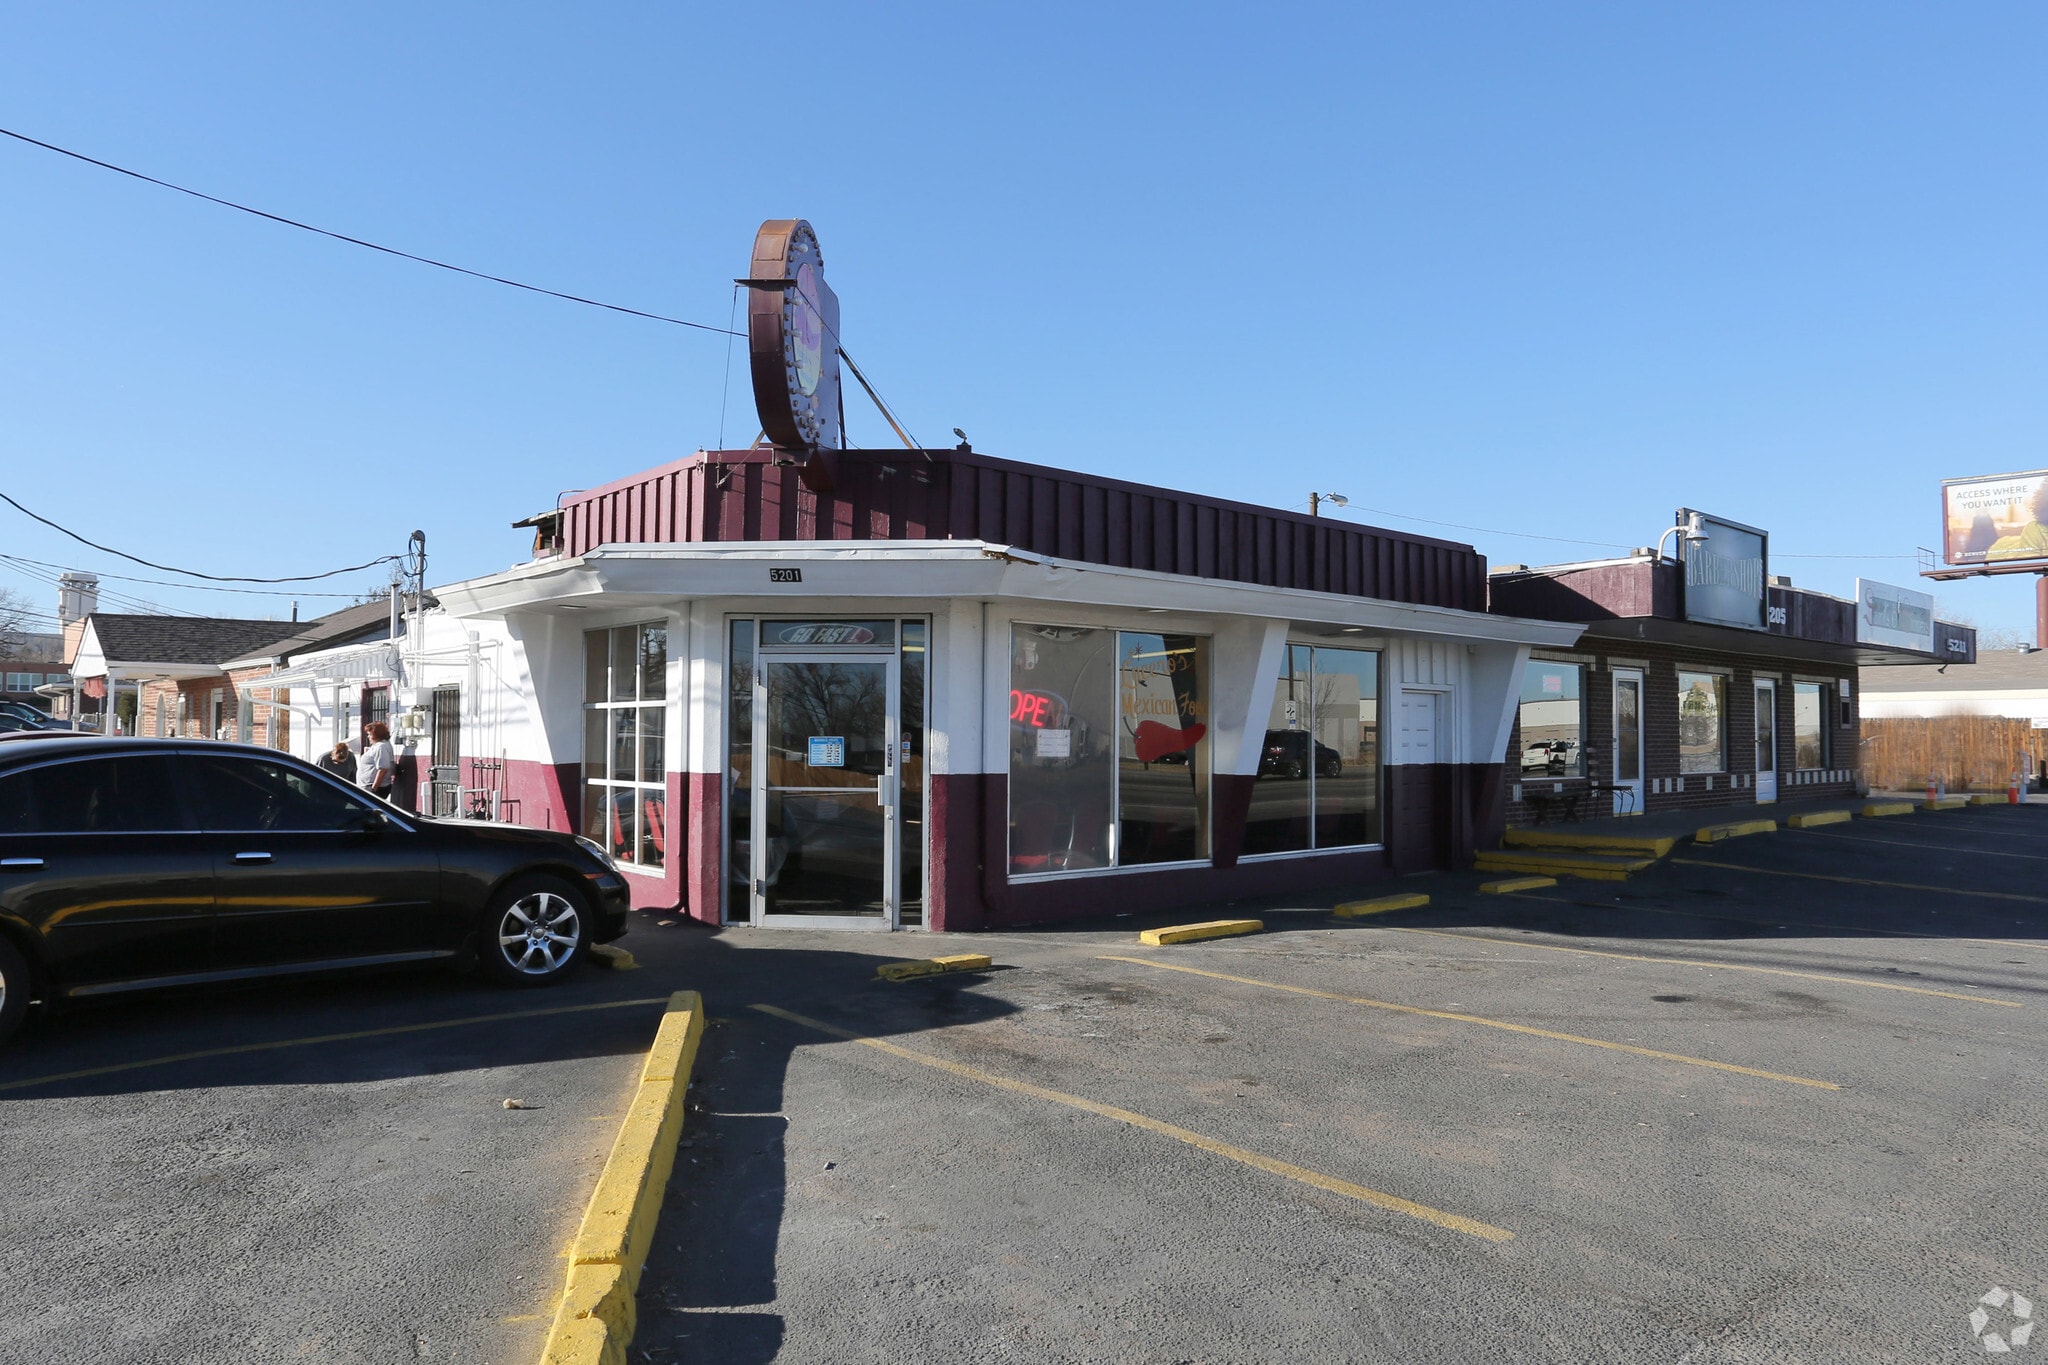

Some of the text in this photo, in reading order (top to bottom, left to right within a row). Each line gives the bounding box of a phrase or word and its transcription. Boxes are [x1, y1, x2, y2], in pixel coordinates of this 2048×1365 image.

[1956, 485, 2028, 500] ACCESS WHERE
[1962, 496, 2023, 509] YOU WANT IT
[771, 568, 800, 582] 5201
[1769, 606, 1787, 625] 205
[790, 627, 816, 643] GO
[1947, 638, 1967, 653] 5211
[1009, 689, 1063, 728] OPEN
[1121, 692, 1178, 719] Mexican
